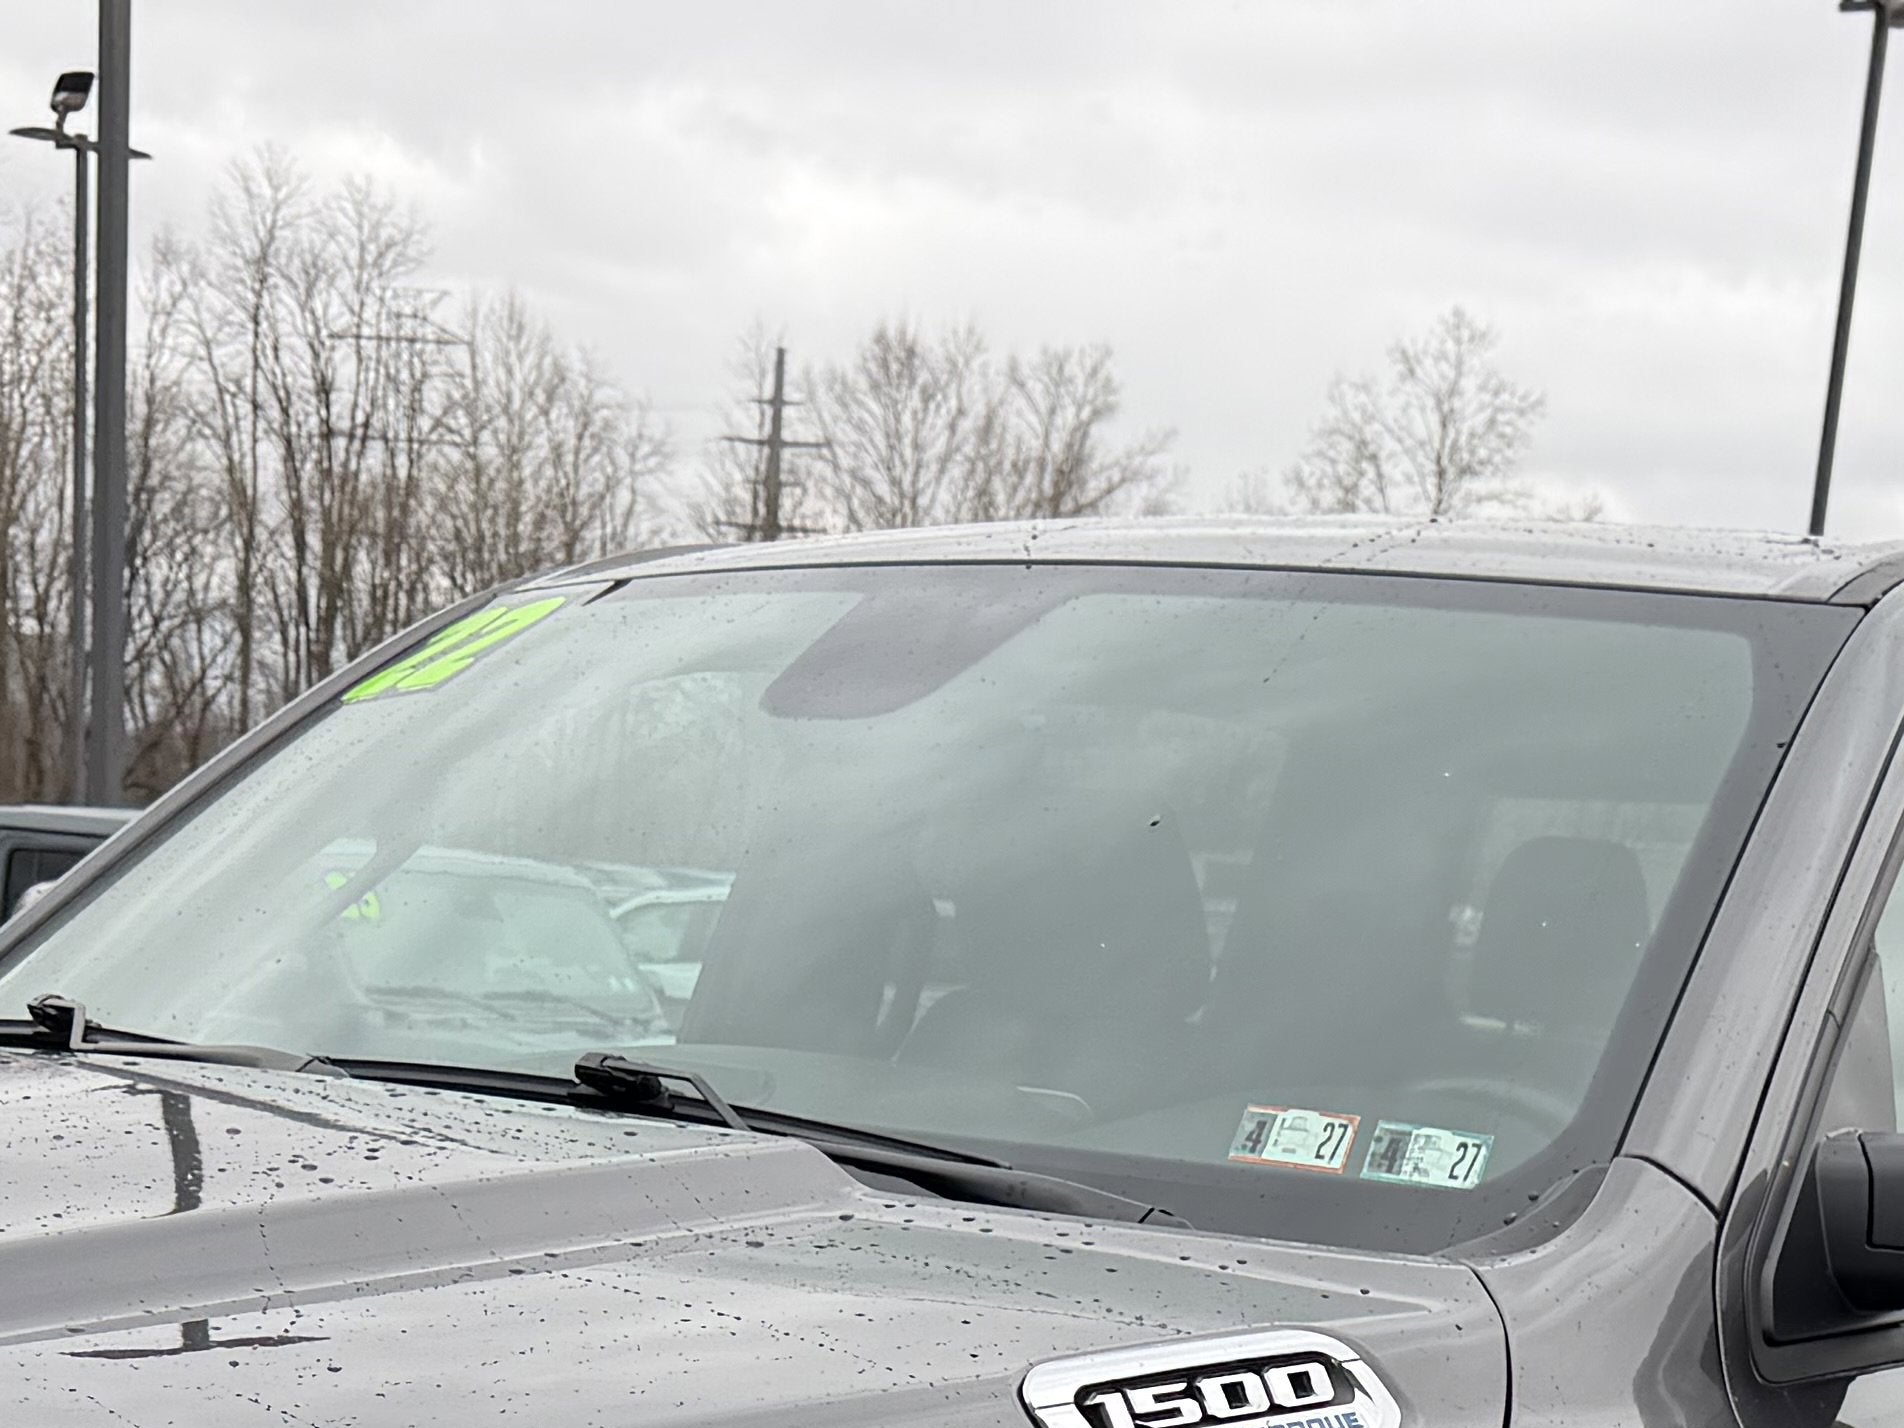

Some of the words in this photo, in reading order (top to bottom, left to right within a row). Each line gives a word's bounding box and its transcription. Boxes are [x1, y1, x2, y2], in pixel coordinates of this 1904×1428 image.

[1245, 1120, 1267, 1154] 4
[1314, 1121, 1350, 1164] 27
[1448, 1141, 1482, 1182] 27
